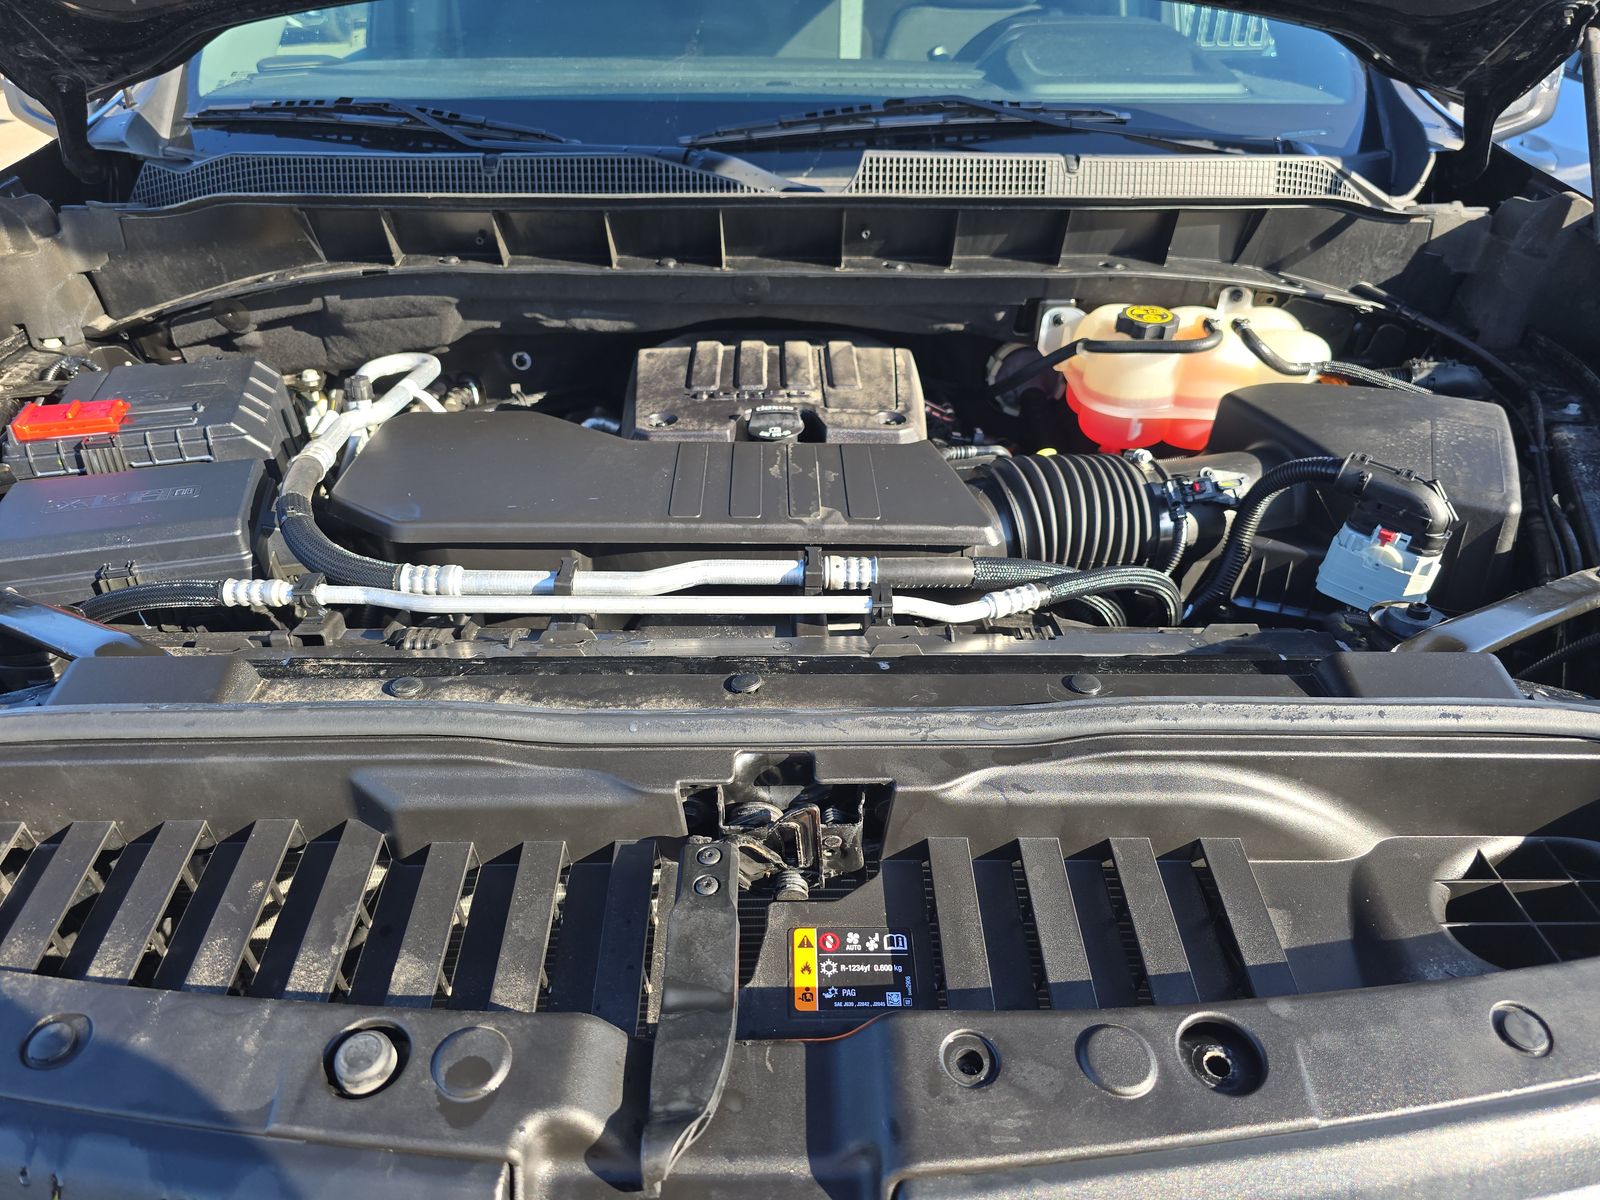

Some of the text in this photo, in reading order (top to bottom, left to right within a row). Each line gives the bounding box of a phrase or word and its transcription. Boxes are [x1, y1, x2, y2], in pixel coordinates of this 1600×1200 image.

[840, 964, 870, 973] R-1234yf
[894, 964, 902, 973] kg
[842, 989, 856, 997] PAG
